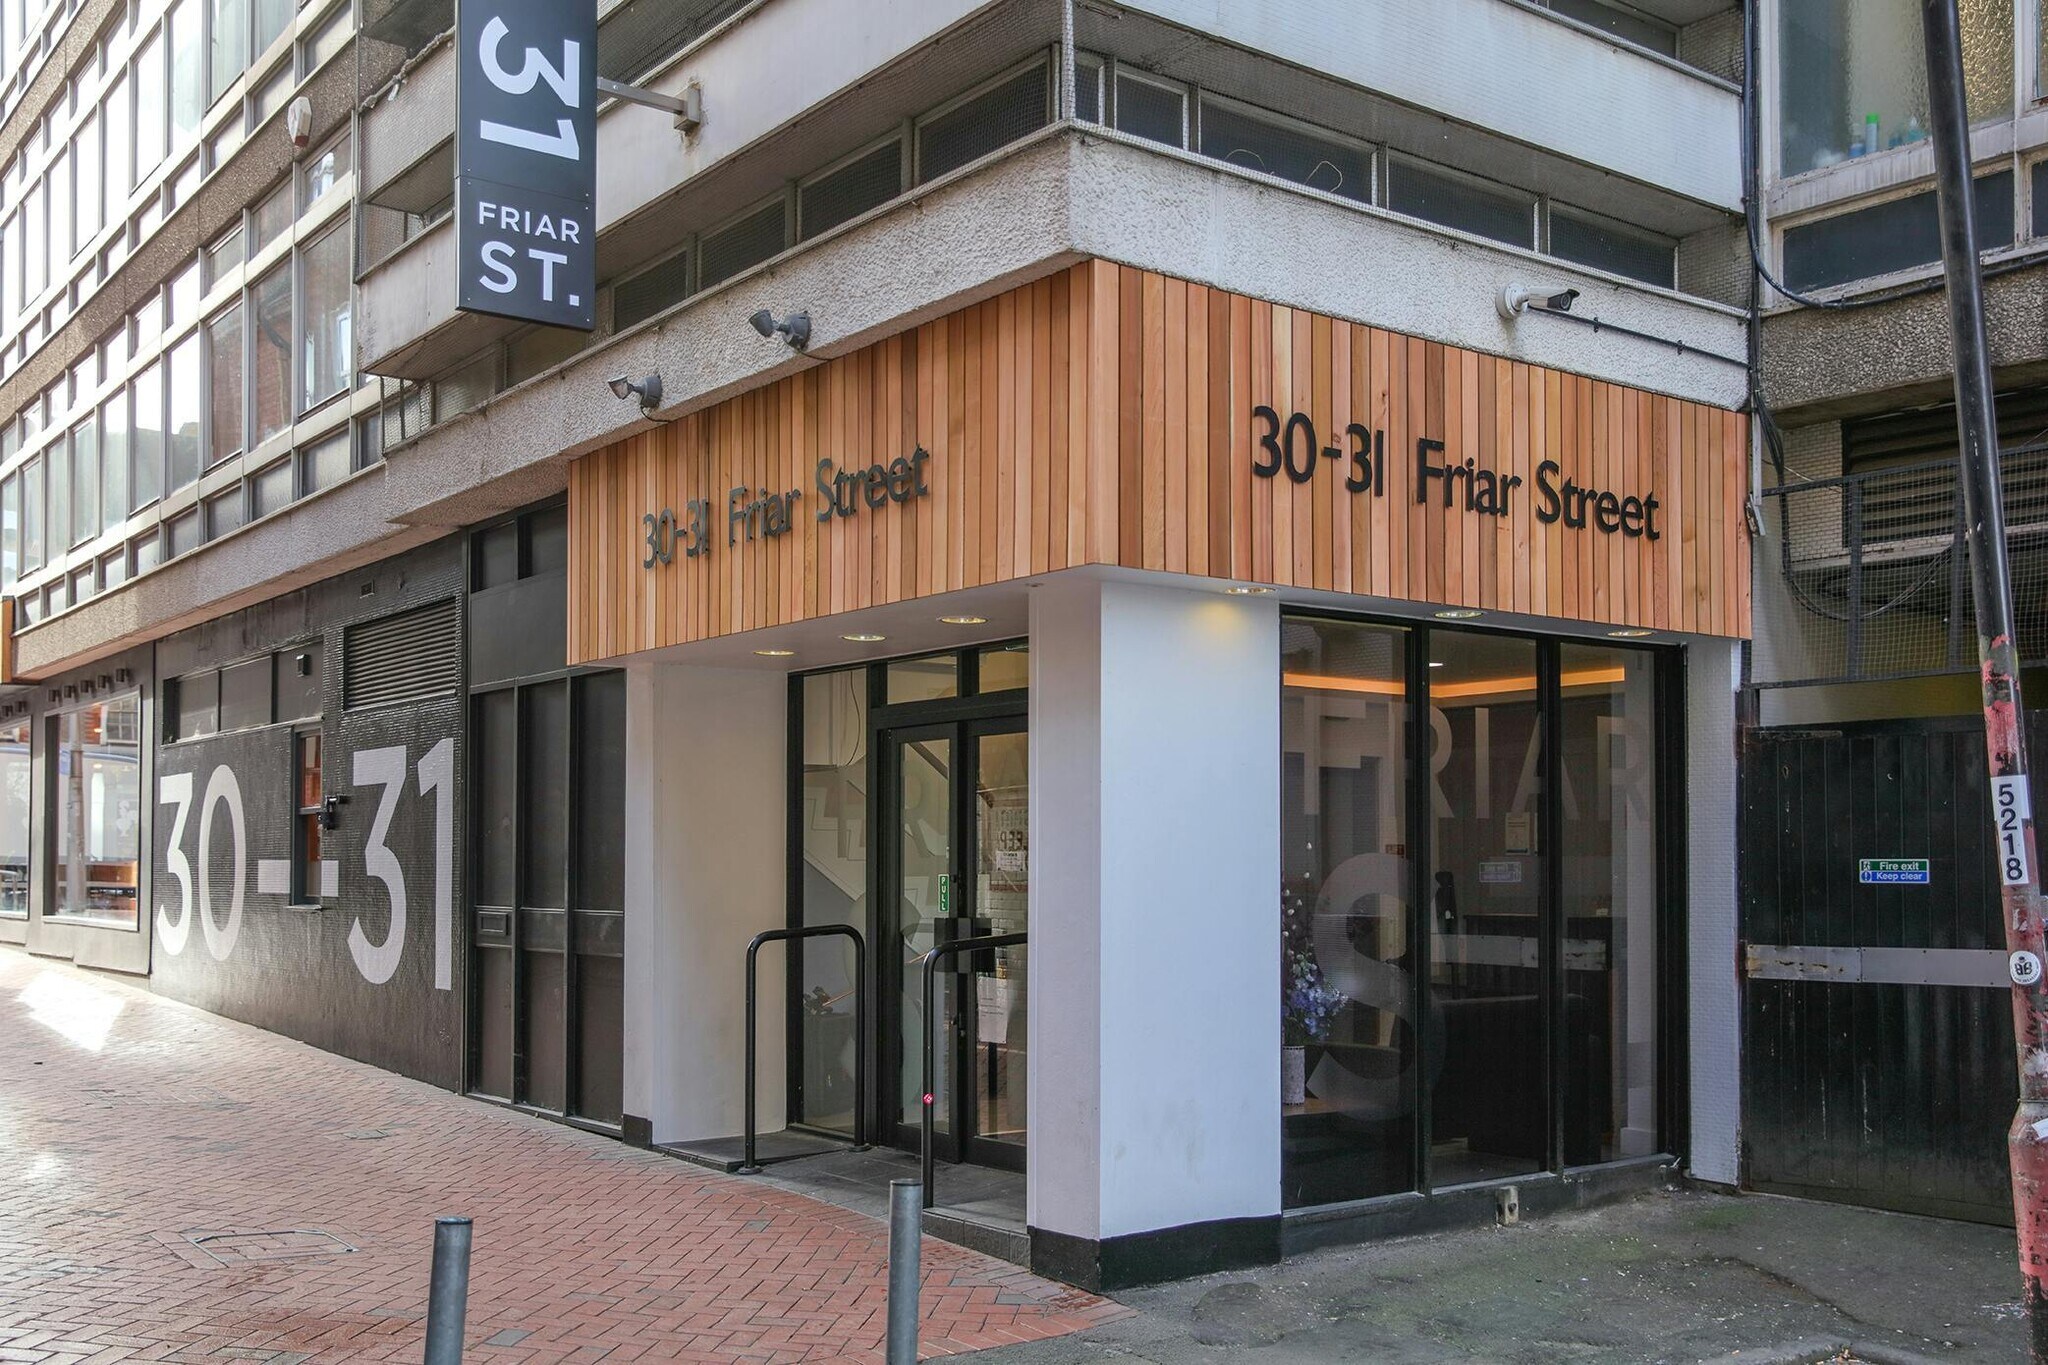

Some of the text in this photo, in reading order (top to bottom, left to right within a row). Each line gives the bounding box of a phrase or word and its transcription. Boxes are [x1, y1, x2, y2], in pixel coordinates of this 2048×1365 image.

[478, 201, 581, 244] FRIAR
[478, 240, 580, 307] ST.
[643, 442, 930, 571] 30-31 Friar Street
[1252, 405, 1661, 541] 30-31 Friar Street
[155, 737, 455, 991] 30-31
[1879, 861, 1919, 871] Fire exit
[1998, 783, 2024, 881] 5218
[1876, 872, 1922, 882] Keep clear
